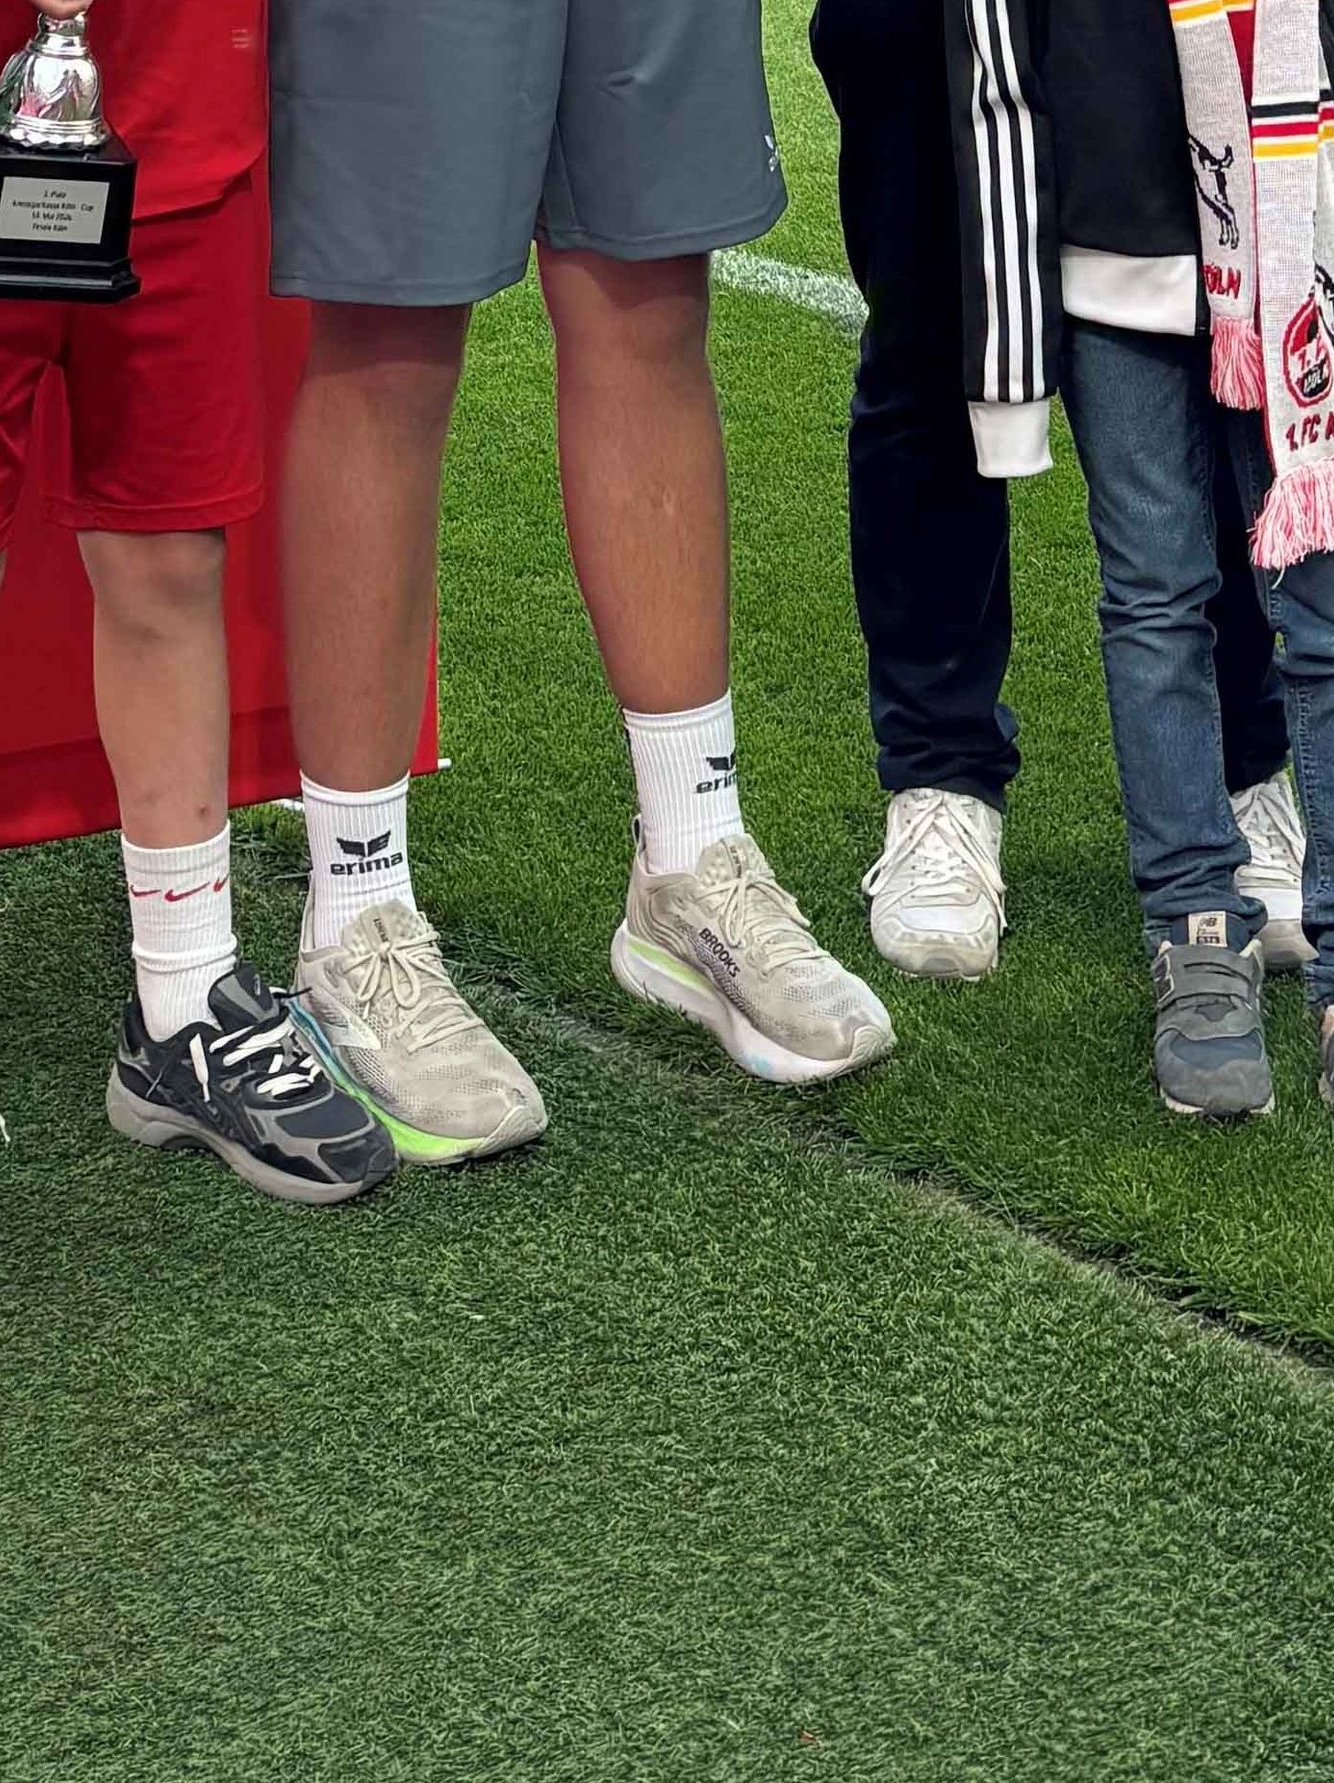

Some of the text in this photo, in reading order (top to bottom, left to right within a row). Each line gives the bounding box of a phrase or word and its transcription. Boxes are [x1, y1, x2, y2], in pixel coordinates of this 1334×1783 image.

[1301, 414, 1321, 446] FC
[330, 851, 404, 876] erima
[698, 928, 741, 979] BROOKS
